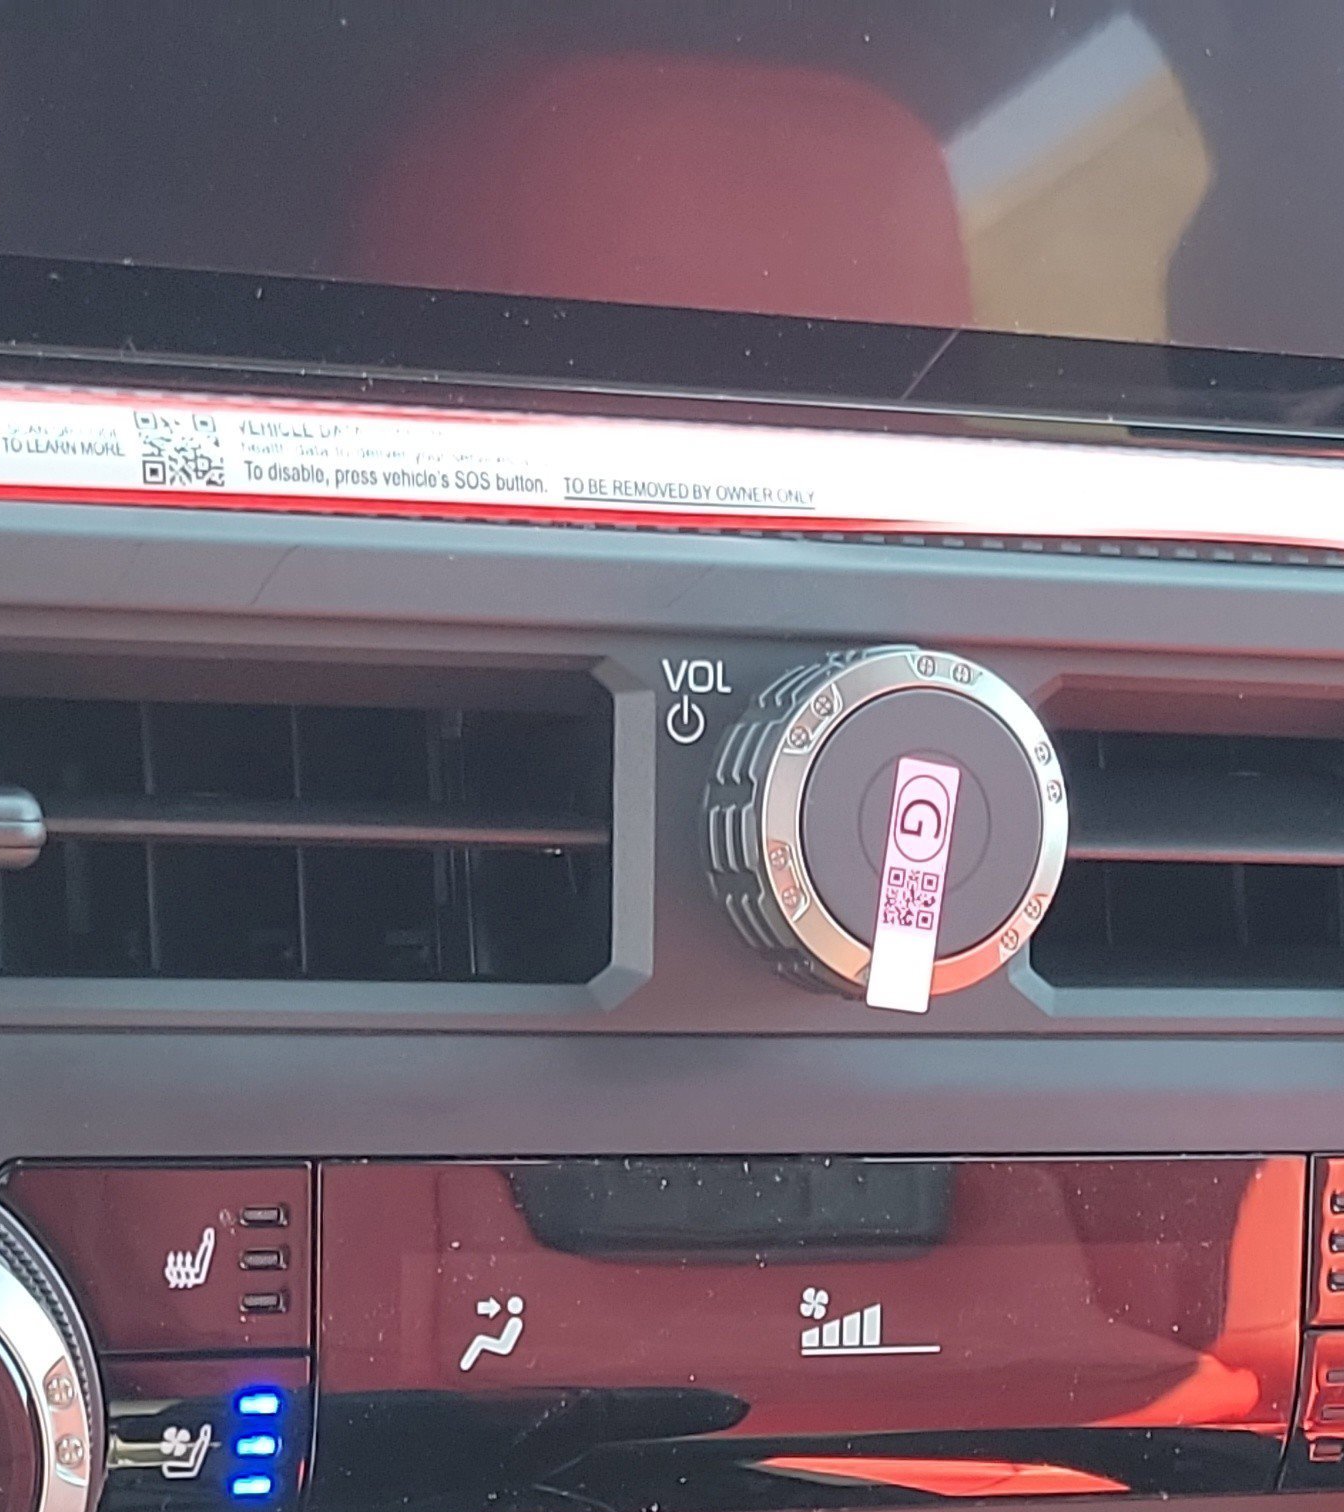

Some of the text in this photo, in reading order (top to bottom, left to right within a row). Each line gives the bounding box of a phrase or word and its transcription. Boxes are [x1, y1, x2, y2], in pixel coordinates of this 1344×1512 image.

[2, 437, 126, 457] TO LEARN MORE
[244, 460, 548, 494] To disable, press vehicle's SOS button.
[564, 477, 584, 495] TO
[588, 478, 608, 496] BE
[613, 479, 689, 501] REMOVED
[693, 482, 711, 501] BY
[716, 485, 773, 503] OWNER
[662, 658, 732, 694] VOL
